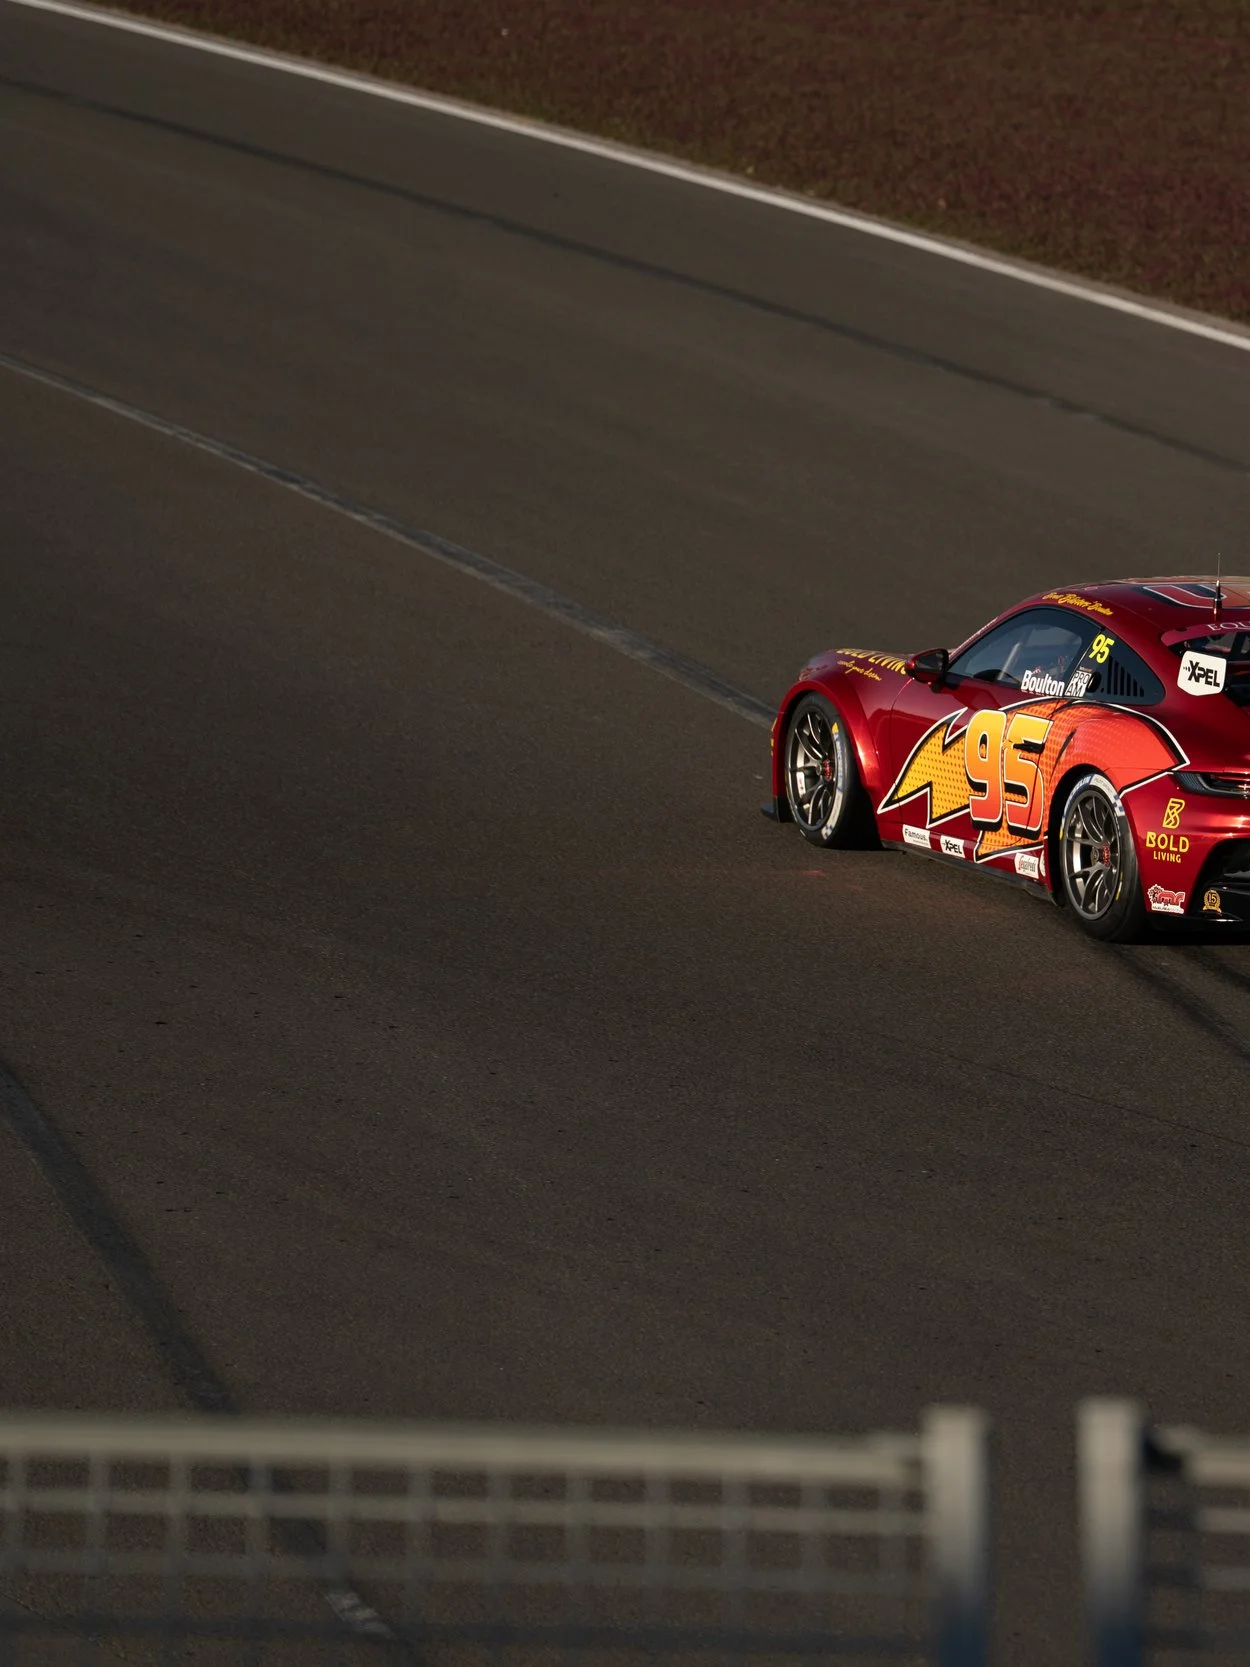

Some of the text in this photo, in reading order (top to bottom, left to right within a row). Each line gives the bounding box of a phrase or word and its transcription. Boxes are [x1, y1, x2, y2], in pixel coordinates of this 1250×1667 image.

[1088, 633, 1115, 664] 95
[1020, 669, 1065, 697] Boulton
[1187, 659, 1221, 688] XPEL
[964, 708, 1054, 839] 95
[944, 840, 963, 855] XPEL
[1146, 831, 1190, 853] BOLD
[1153, 850, 1182, 863] LIVING
